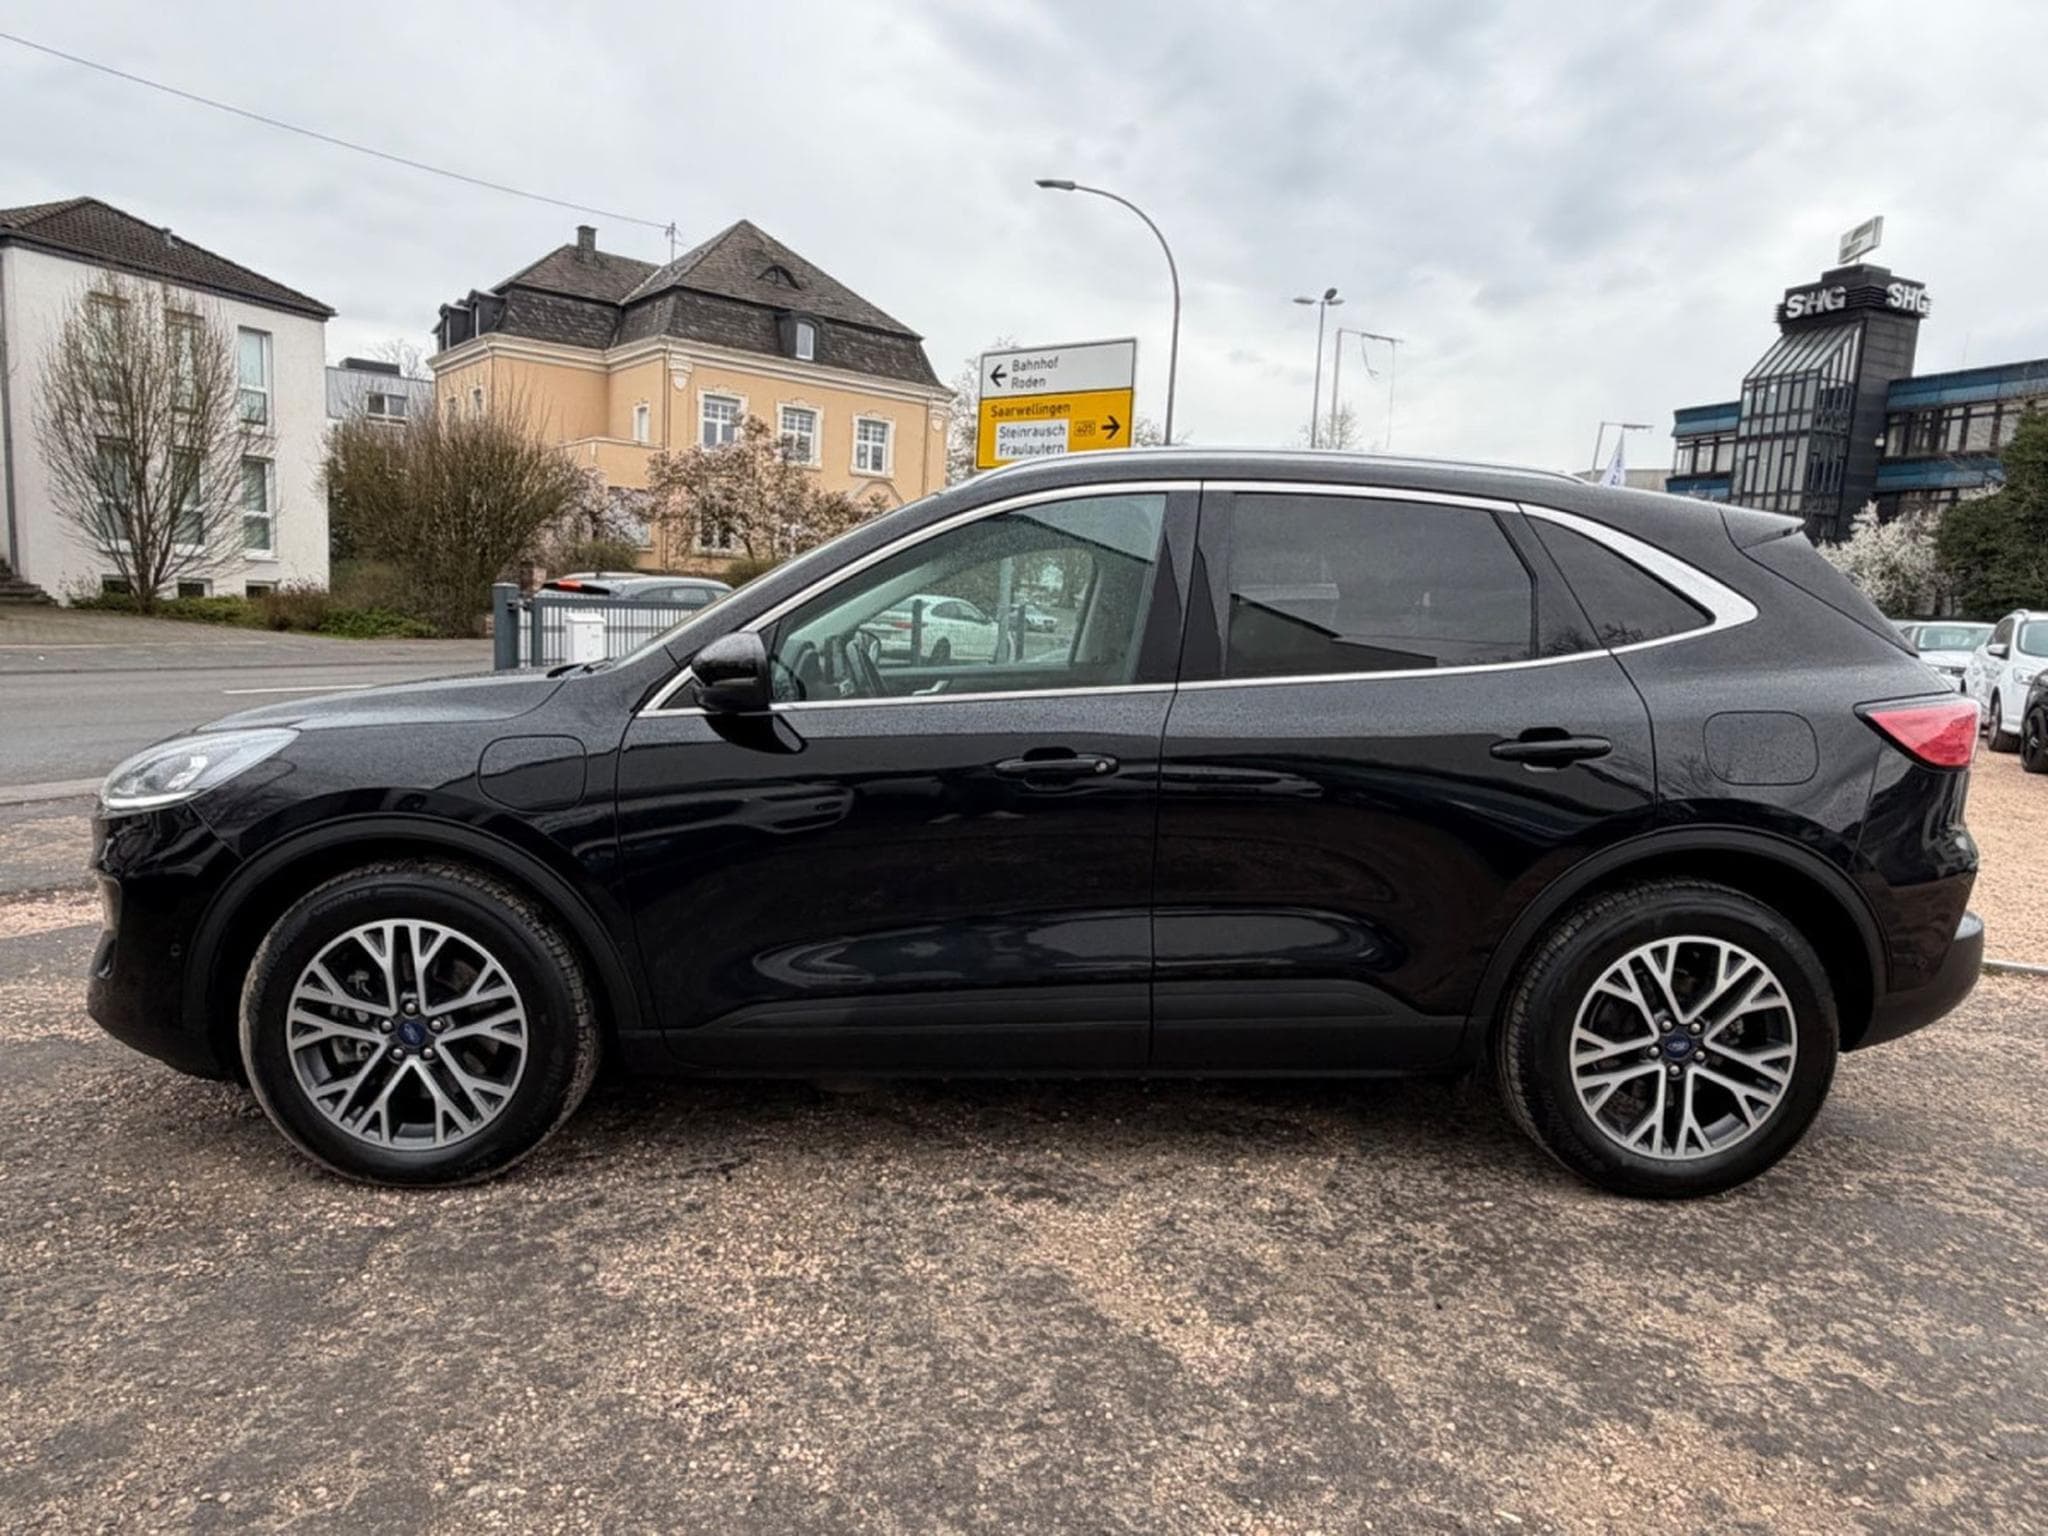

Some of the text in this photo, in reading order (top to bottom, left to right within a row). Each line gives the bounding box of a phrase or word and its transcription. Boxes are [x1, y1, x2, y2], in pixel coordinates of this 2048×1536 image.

[1786, 286, 1846, 318] SHG
[1886, 283, 1930, 313] SHG
[1011, 356, 1059, 372] Bahnhof
[1011, 376, 1047, 389] Roden
[990, 402, 1071, 418] Saarwellingen
[999, 423, 1066, 439] Steinrausch
[999, 442, 1065, 456] Fraulautern
